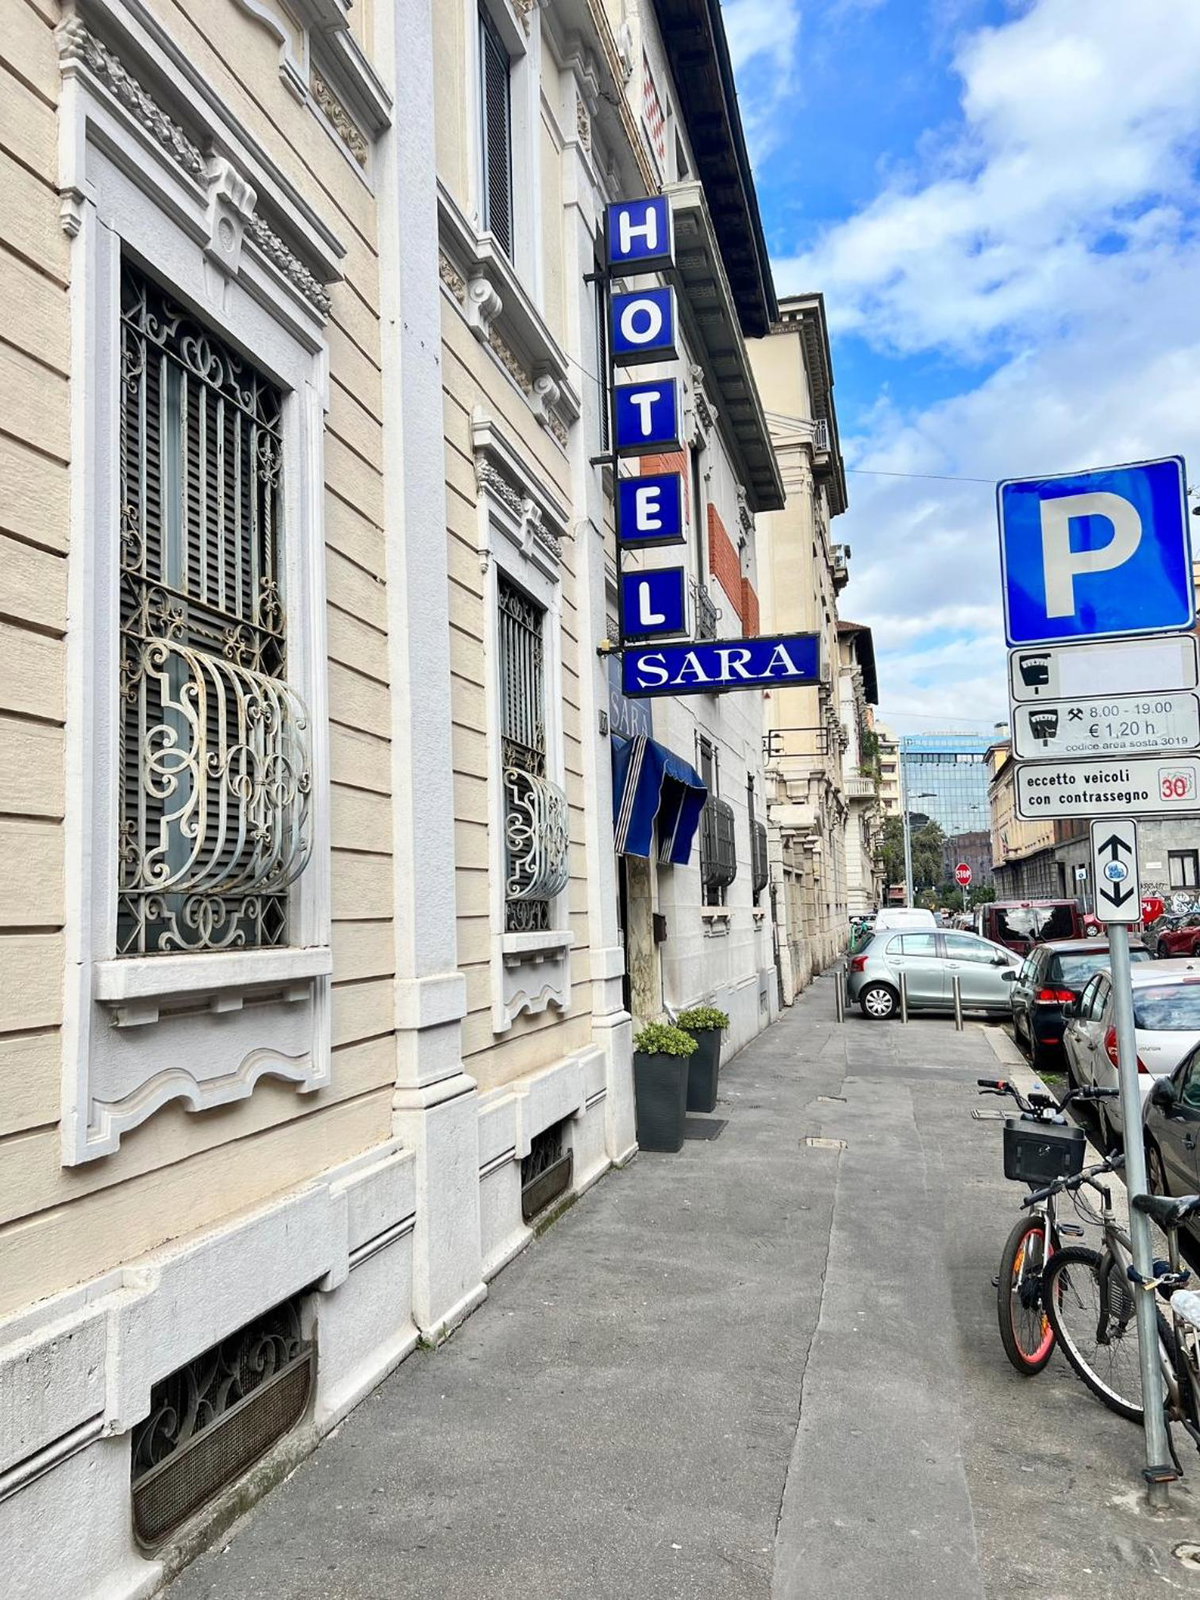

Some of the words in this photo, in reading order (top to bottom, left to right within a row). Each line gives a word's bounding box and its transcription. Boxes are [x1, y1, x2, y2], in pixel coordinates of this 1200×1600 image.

[618, 205, 666, 627] HOTEL
[1039, 491, 1143, 619] P
[636, 643, 805, 689] SARA
[611, 690, 648, 738] SARA
[1089, 704, 1120, 719] 8.00
[1134, 701, 1173, 716] 19.00
[1089, 723, 1100, 738] €
[1105, 721, 1140, 740] 1,20
[1145, 720, 1156, 735] h
[1065, 742, 1100, 752] codice
[1102, 741, 1127, 750] area
[1129, 738, 1158, 749] sosta
[1160, 736, 1189, 746] 3019
[1027, 773, 1076, 787] eccetto
[1083, 769, 1130, 785] veicoli
[1161, 778, 1186, 798] 30
[1028, 795, 1051, 806] con
[1058, 790, 1149, 804] contrassegno
[956, 870, 971, 878] STOP
